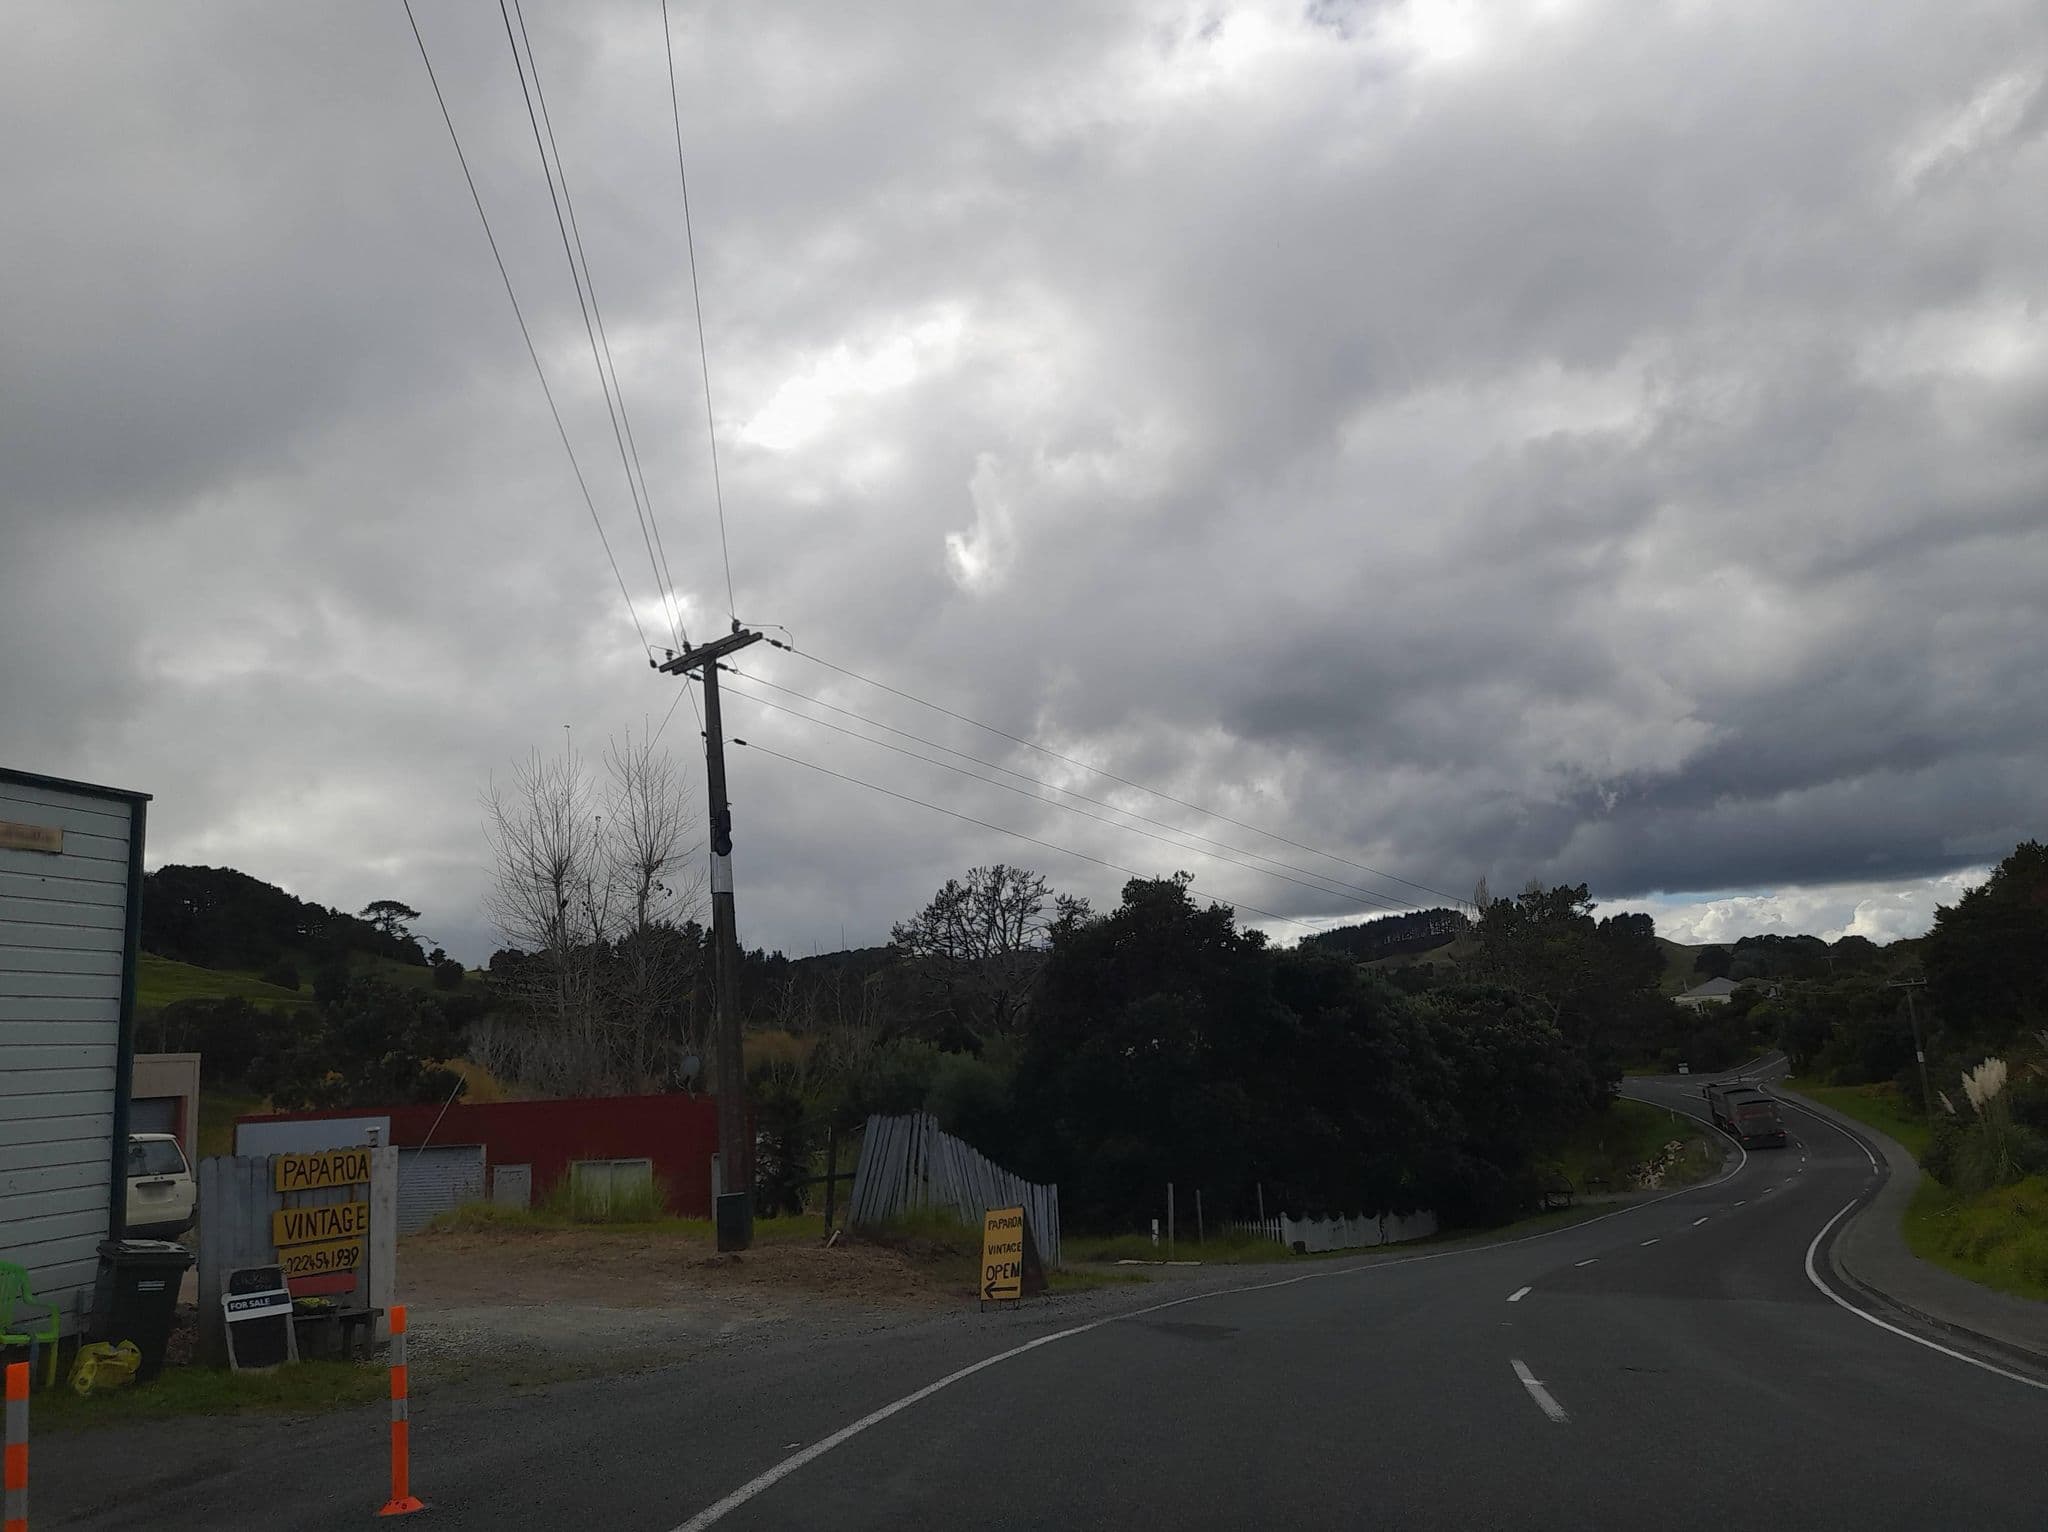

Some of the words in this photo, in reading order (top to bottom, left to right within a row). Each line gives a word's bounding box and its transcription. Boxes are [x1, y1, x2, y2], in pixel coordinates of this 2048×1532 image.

[283, 1154, 369, 1187] PAPAROA
[283, 1206, 367, 1240] VINTAGE
[988, 1216, 1023, 1231] PAPAROA
[988, 1242, 1022, 1255] VINTAGE
[985, 1261, 1020, 1281] OPEN
[230, 1301, 249, 1311] FOR
[249, 1297, 271, 1308] SALE
